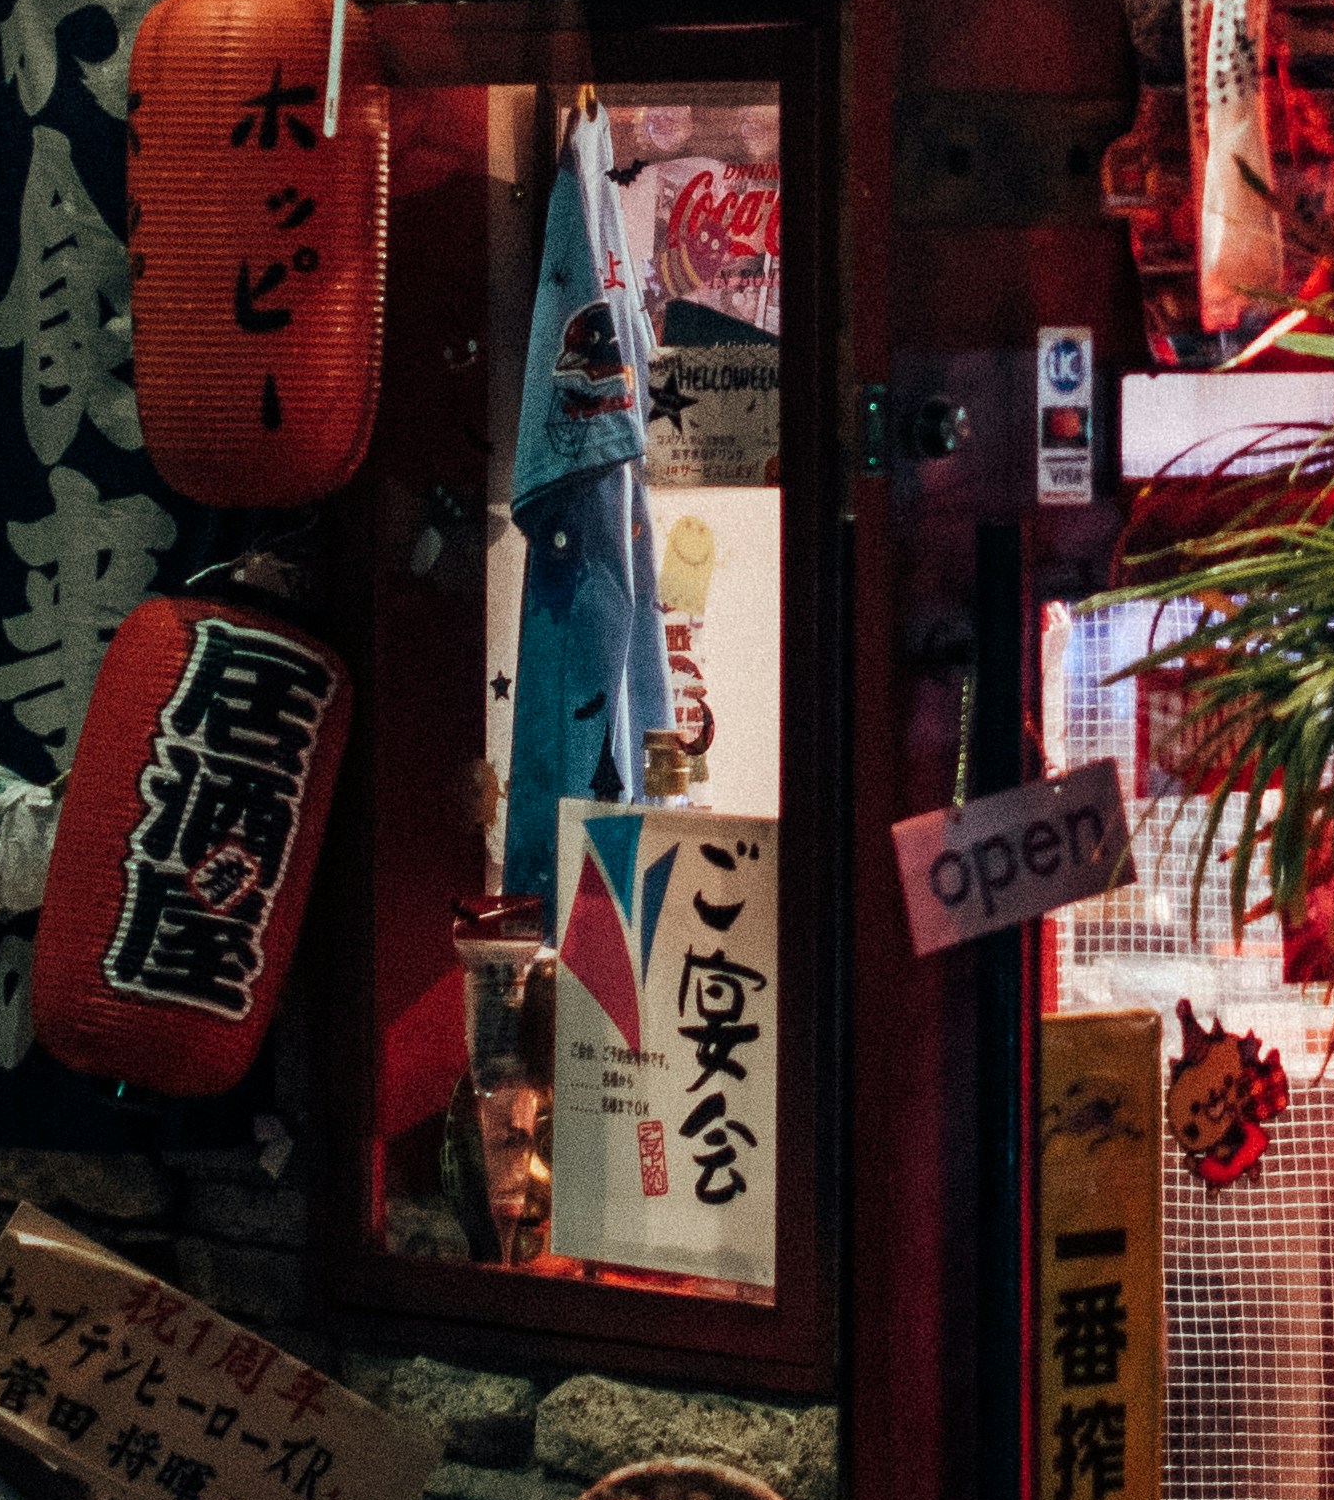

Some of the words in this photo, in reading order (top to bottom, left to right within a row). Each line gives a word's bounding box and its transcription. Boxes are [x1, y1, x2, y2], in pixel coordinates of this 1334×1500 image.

[230, 58, 319, 434] ホッピー
[103, 617, 341, 1023] 居酒屋
[929, 801, 1108, 919] open
[677, 839, 768, 1205] ご宴会
[125, 1277, 331, 1424] 祝1周年
